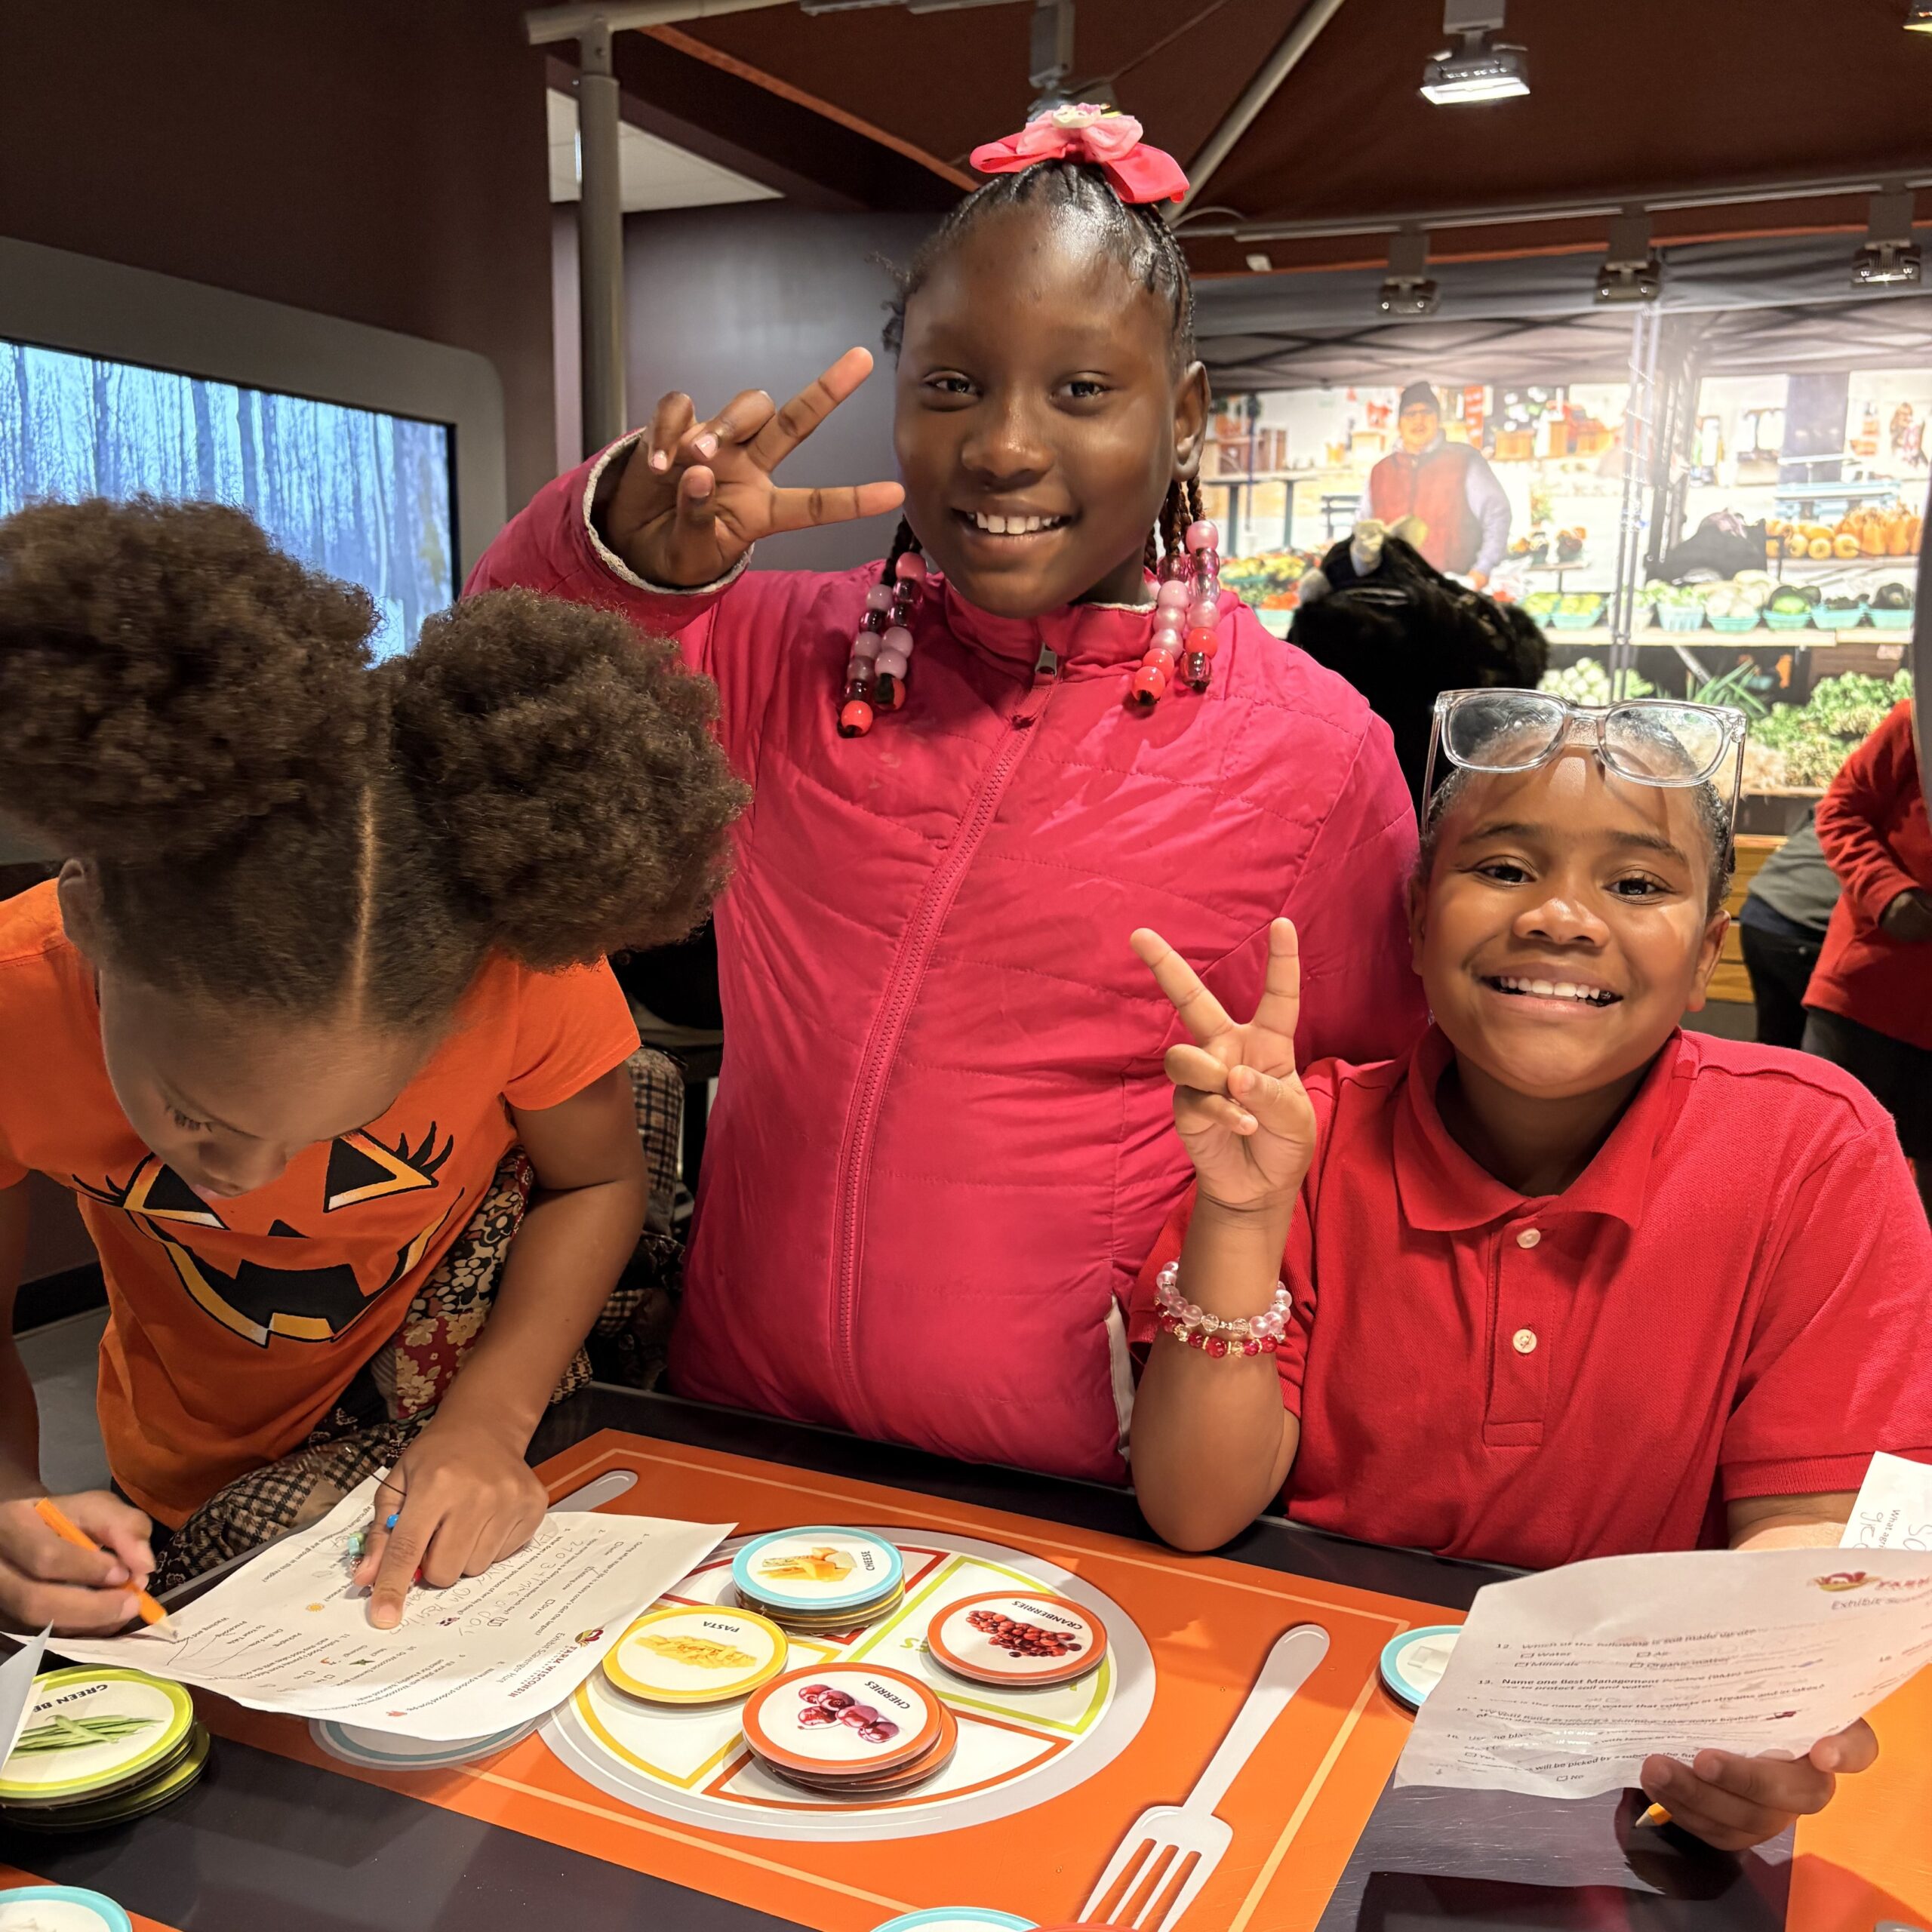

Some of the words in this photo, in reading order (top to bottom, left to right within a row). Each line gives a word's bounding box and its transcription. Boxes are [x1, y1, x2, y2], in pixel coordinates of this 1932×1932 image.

[1884, 1509, 1901, 1531] What
[295, 1547, 312, 1561] grown
[860, 1550, 875, 1571] CHEESE
[279, 1563, 291, 1571] this
[262, 1570, 281, 1582] region?
[1830, 1597, 1882, 1611] Exhibit
[1011, 1600, 1084, 1630] CRANBERRIES
[703, 1620, 740, 1633] PASTA
[553, 1646, 577, 1663] FARM
[509, 1664, 555, 1697] WISCONSIN
[1586, 1678, 1660, 1686] Management
[56, 1684, 109, 1706] GREEN
[864, 1680, 911, 1709] CHERRIES
[1535, 1763, 1552, 1772] will
[1553, 1761, 1567, 1769] be
[1567, 1756, 1600, 1770] picked
